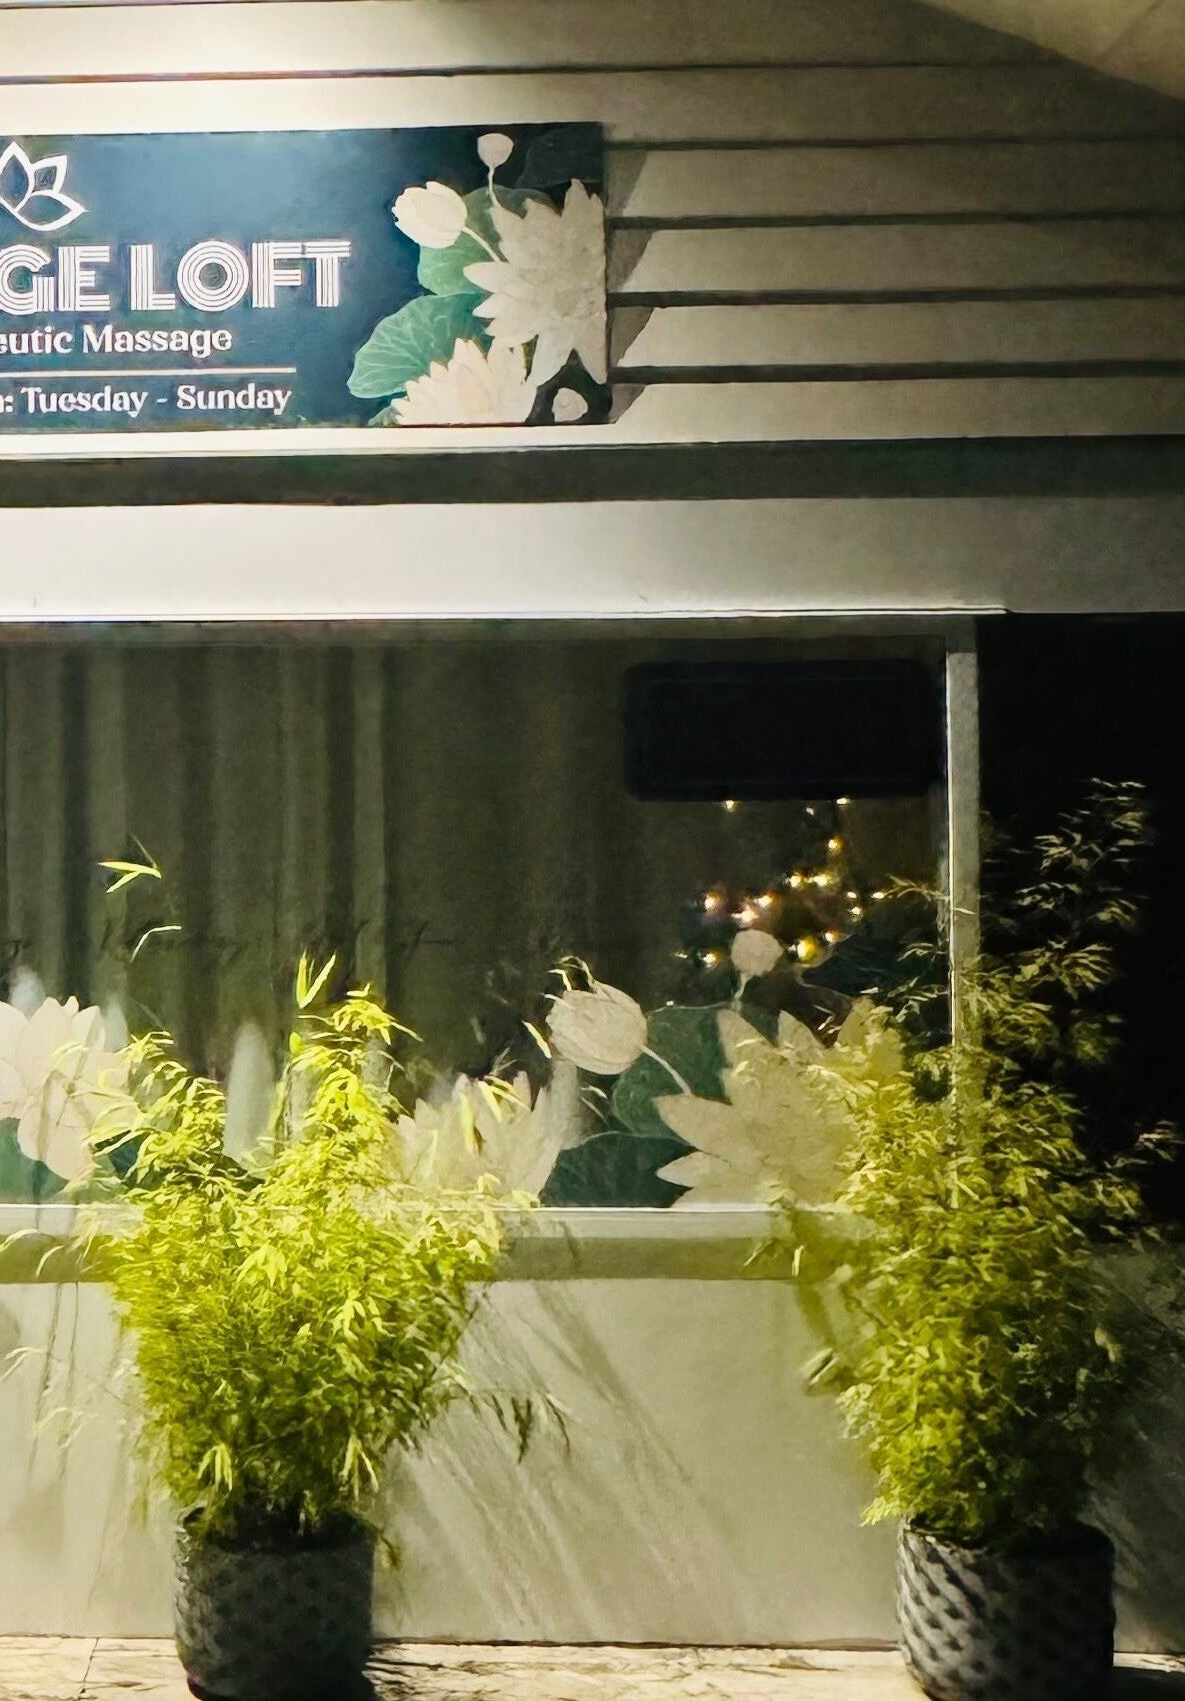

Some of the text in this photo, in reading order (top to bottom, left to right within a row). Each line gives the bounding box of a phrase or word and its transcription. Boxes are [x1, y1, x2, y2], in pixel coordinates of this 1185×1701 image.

[131, 239, 351, 312] LOFT
[82, 324, 233, 358] Massage
[21, 386, 148, 418] Tuesday
[176, 384, 293, 415] Sunday
